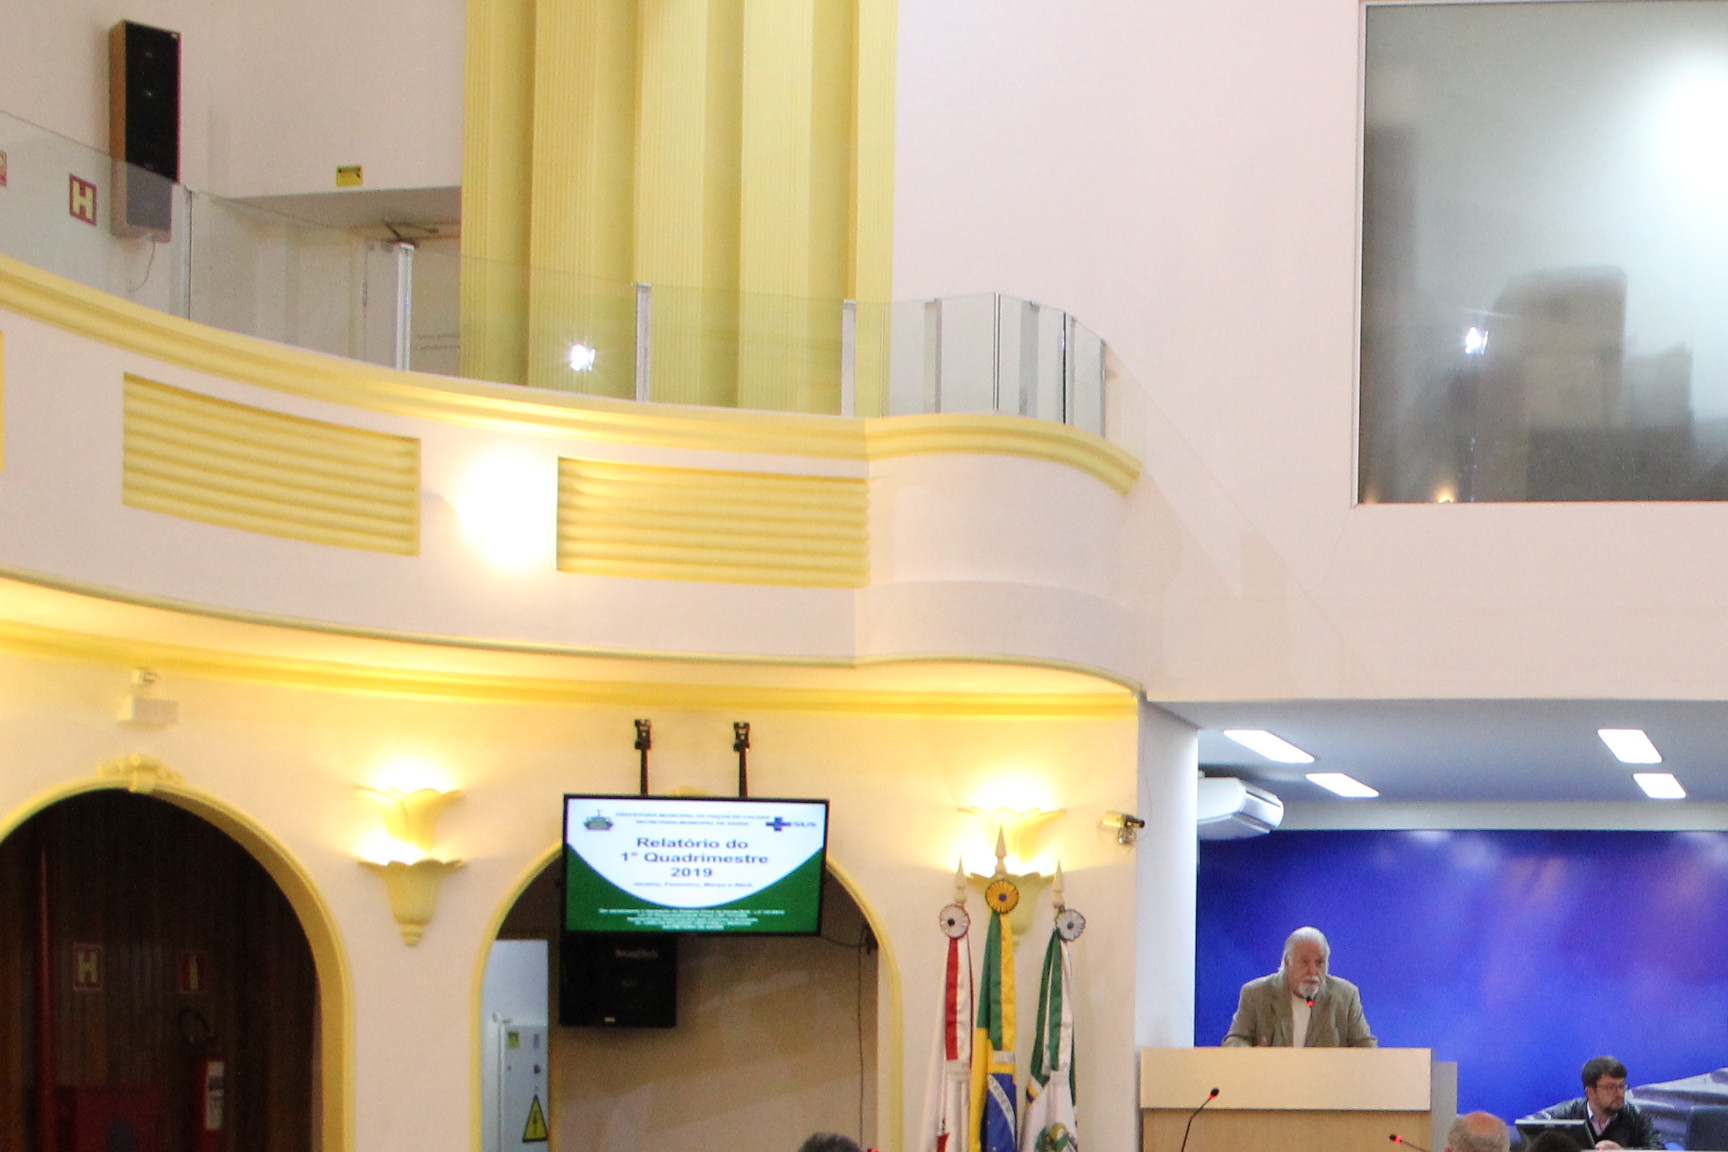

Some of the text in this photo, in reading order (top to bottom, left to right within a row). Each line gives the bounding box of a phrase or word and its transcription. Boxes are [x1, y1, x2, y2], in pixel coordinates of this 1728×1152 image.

[72, 180, 94, 220] H
[637, 837, 748, 849] Relatório do
[644, 852, 768, 864] Quadrimestre
[671, 867, 713, 878] 2019
